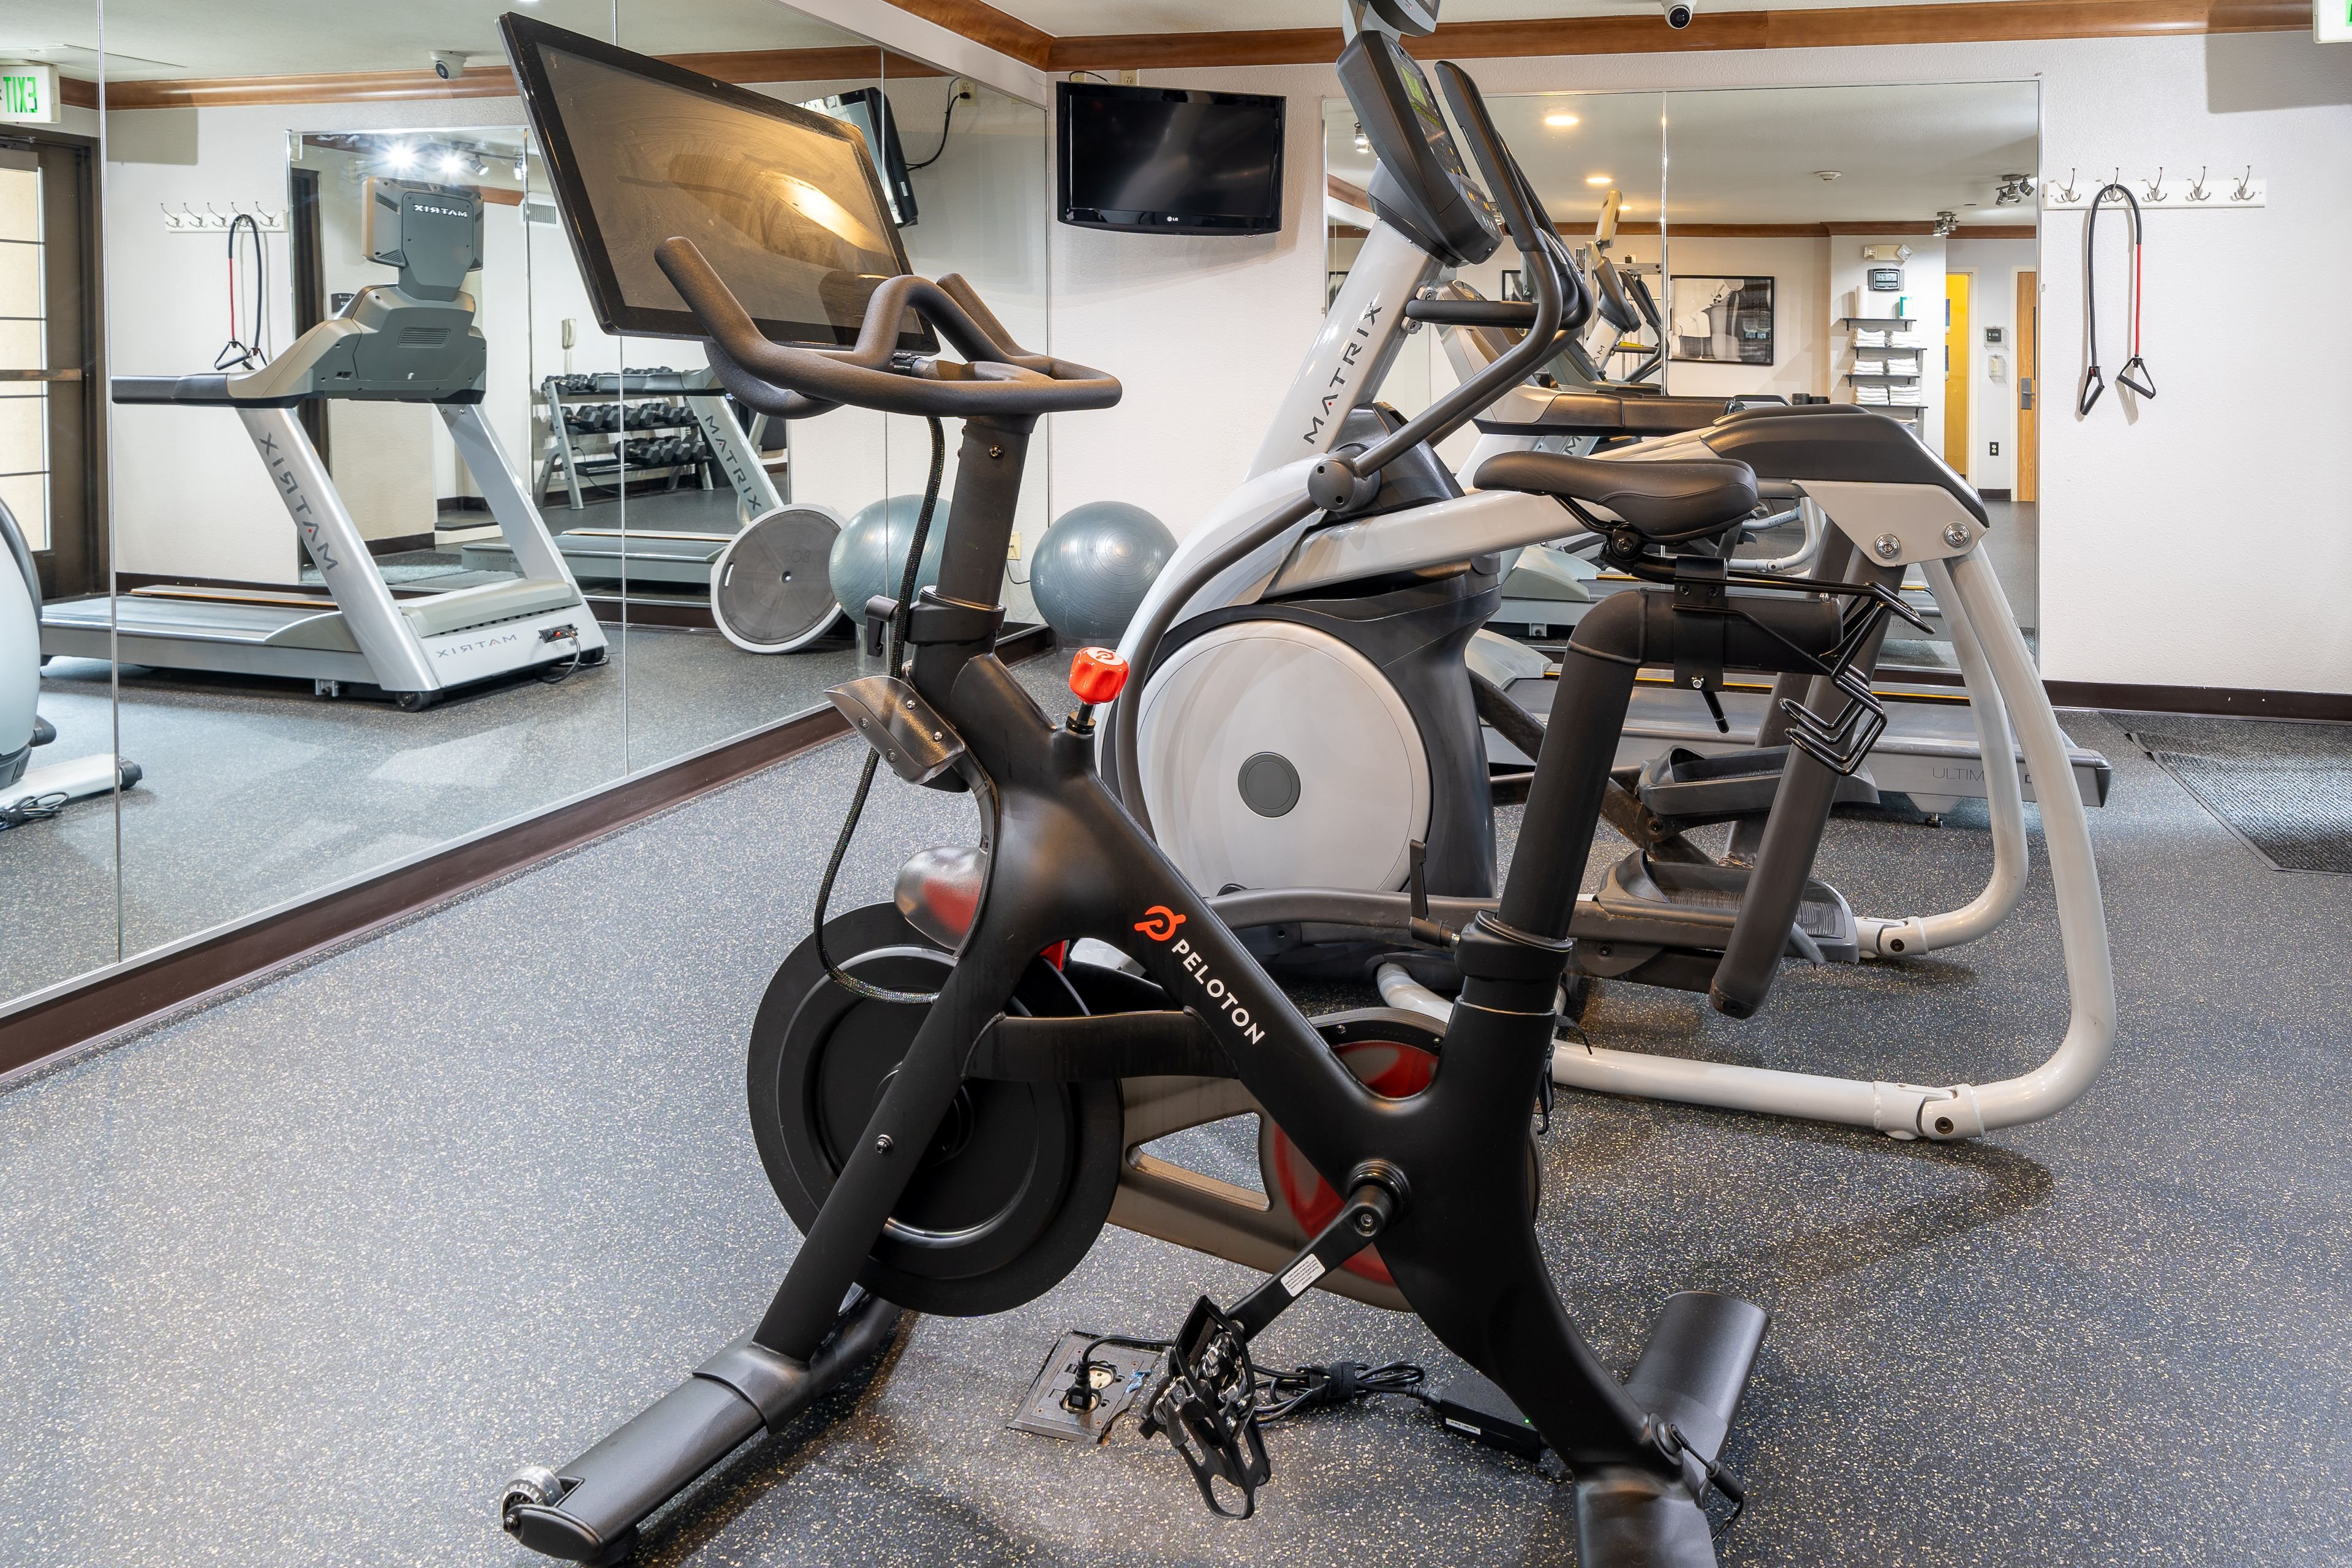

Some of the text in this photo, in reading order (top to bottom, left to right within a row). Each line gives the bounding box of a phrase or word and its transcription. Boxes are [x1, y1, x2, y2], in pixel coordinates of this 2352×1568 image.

[1303, 301, 1382, 445] MATRIX
[705, 415, 762, 511] MATRIX
[1932, 767, 1985, 782] ULTIM
[1172, 939, 1265, 1045] PELOTON
